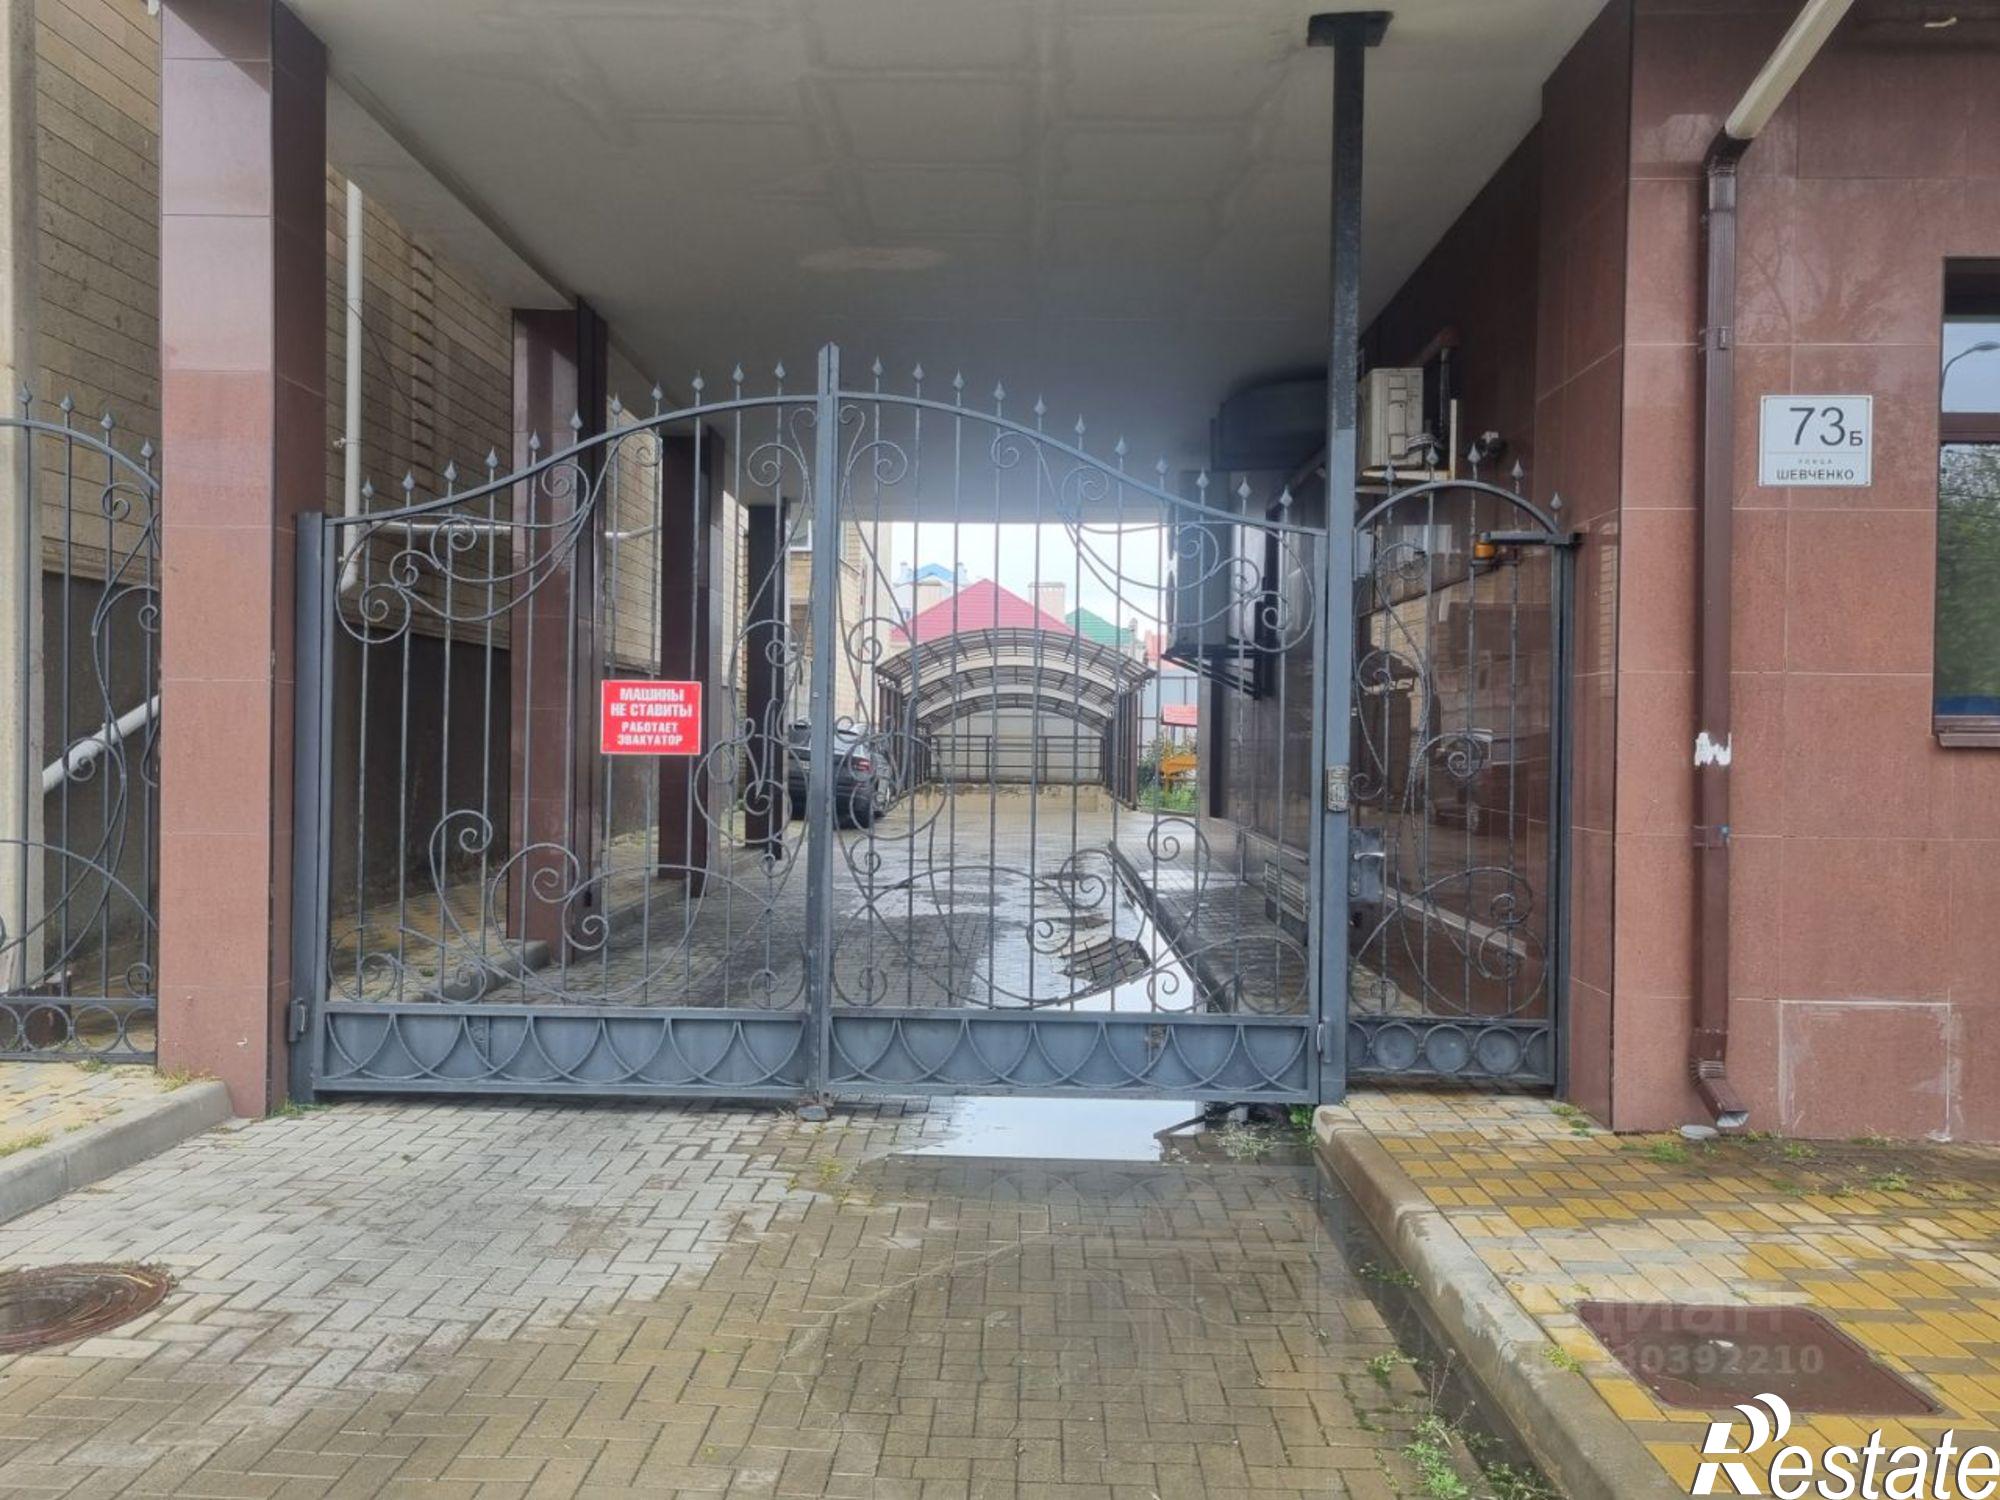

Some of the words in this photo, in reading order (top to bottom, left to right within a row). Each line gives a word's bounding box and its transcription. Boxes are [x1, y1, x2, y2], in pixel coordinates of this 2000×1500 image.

[1776, 468, 1855, 481] ШЕВЧЕНКО
[620, 686, 685, 701] МАШИНЫ
[610, 702, 628, 717] НЕ
[620, 720, 679, 734] РАБОТАЕТ
[616, 733, 684, 746] ЭВАКУАТОР
